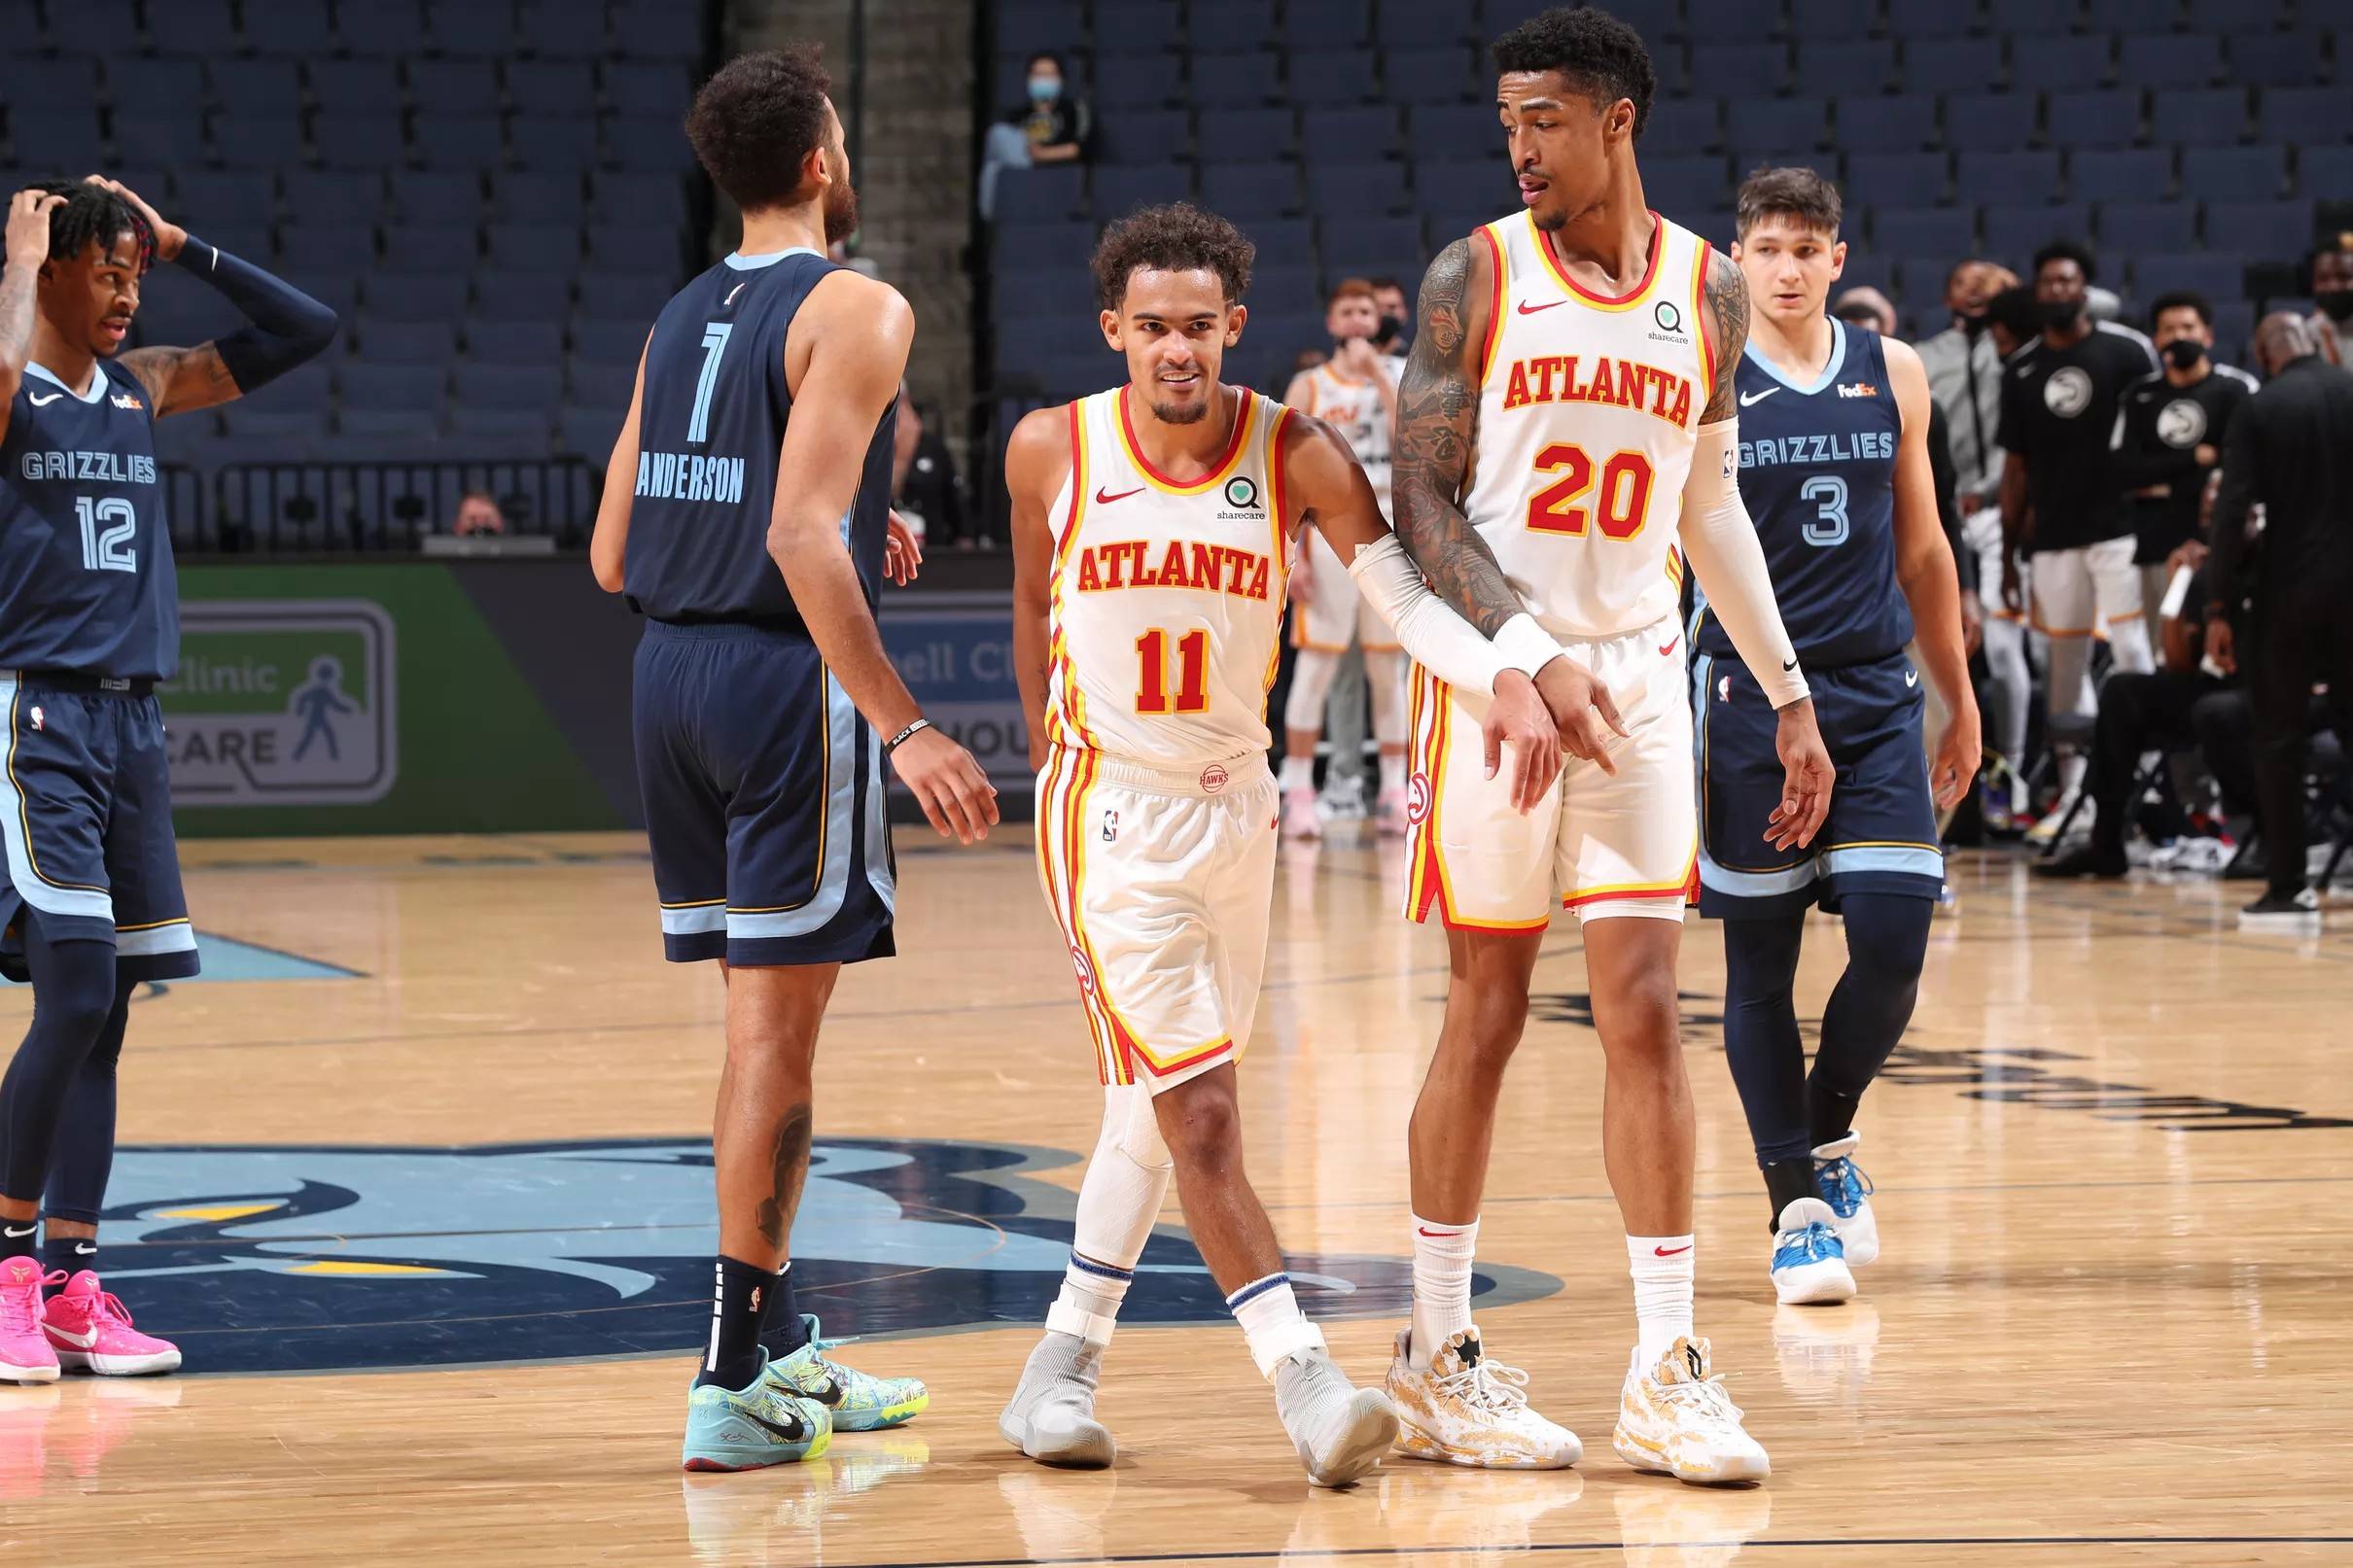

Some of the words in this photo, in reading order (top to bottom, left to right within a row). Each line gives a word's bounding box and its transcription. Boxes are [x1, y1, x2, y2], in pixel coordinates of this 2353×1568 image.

[1647, 331, 1689, 345] sharecare
[686, 322, 734, 443] 7
[1502, 355, 1693, 431] ATLANTA
[1837, 383, 1878, 400] FedEx
[21, 451, 157, 484] GRIZZLIES
[1738, 432, 1894, 469] GRIZZLIES
[634, 451, 745, 504] ANDERSON
[1525, 441, 1656, 542] 20
[75, 496, 136, 573] 12
[1216, 510, 1266, 520] sharecare
[1800, 475, 1850, 547] 3
[1077, 538, 1270, 602] ATLANTA
[1135, 627, 1211, 715] 11
[166, 730, 277, 764] ARE
[1199, 773, 1229, 785] HAWKS
